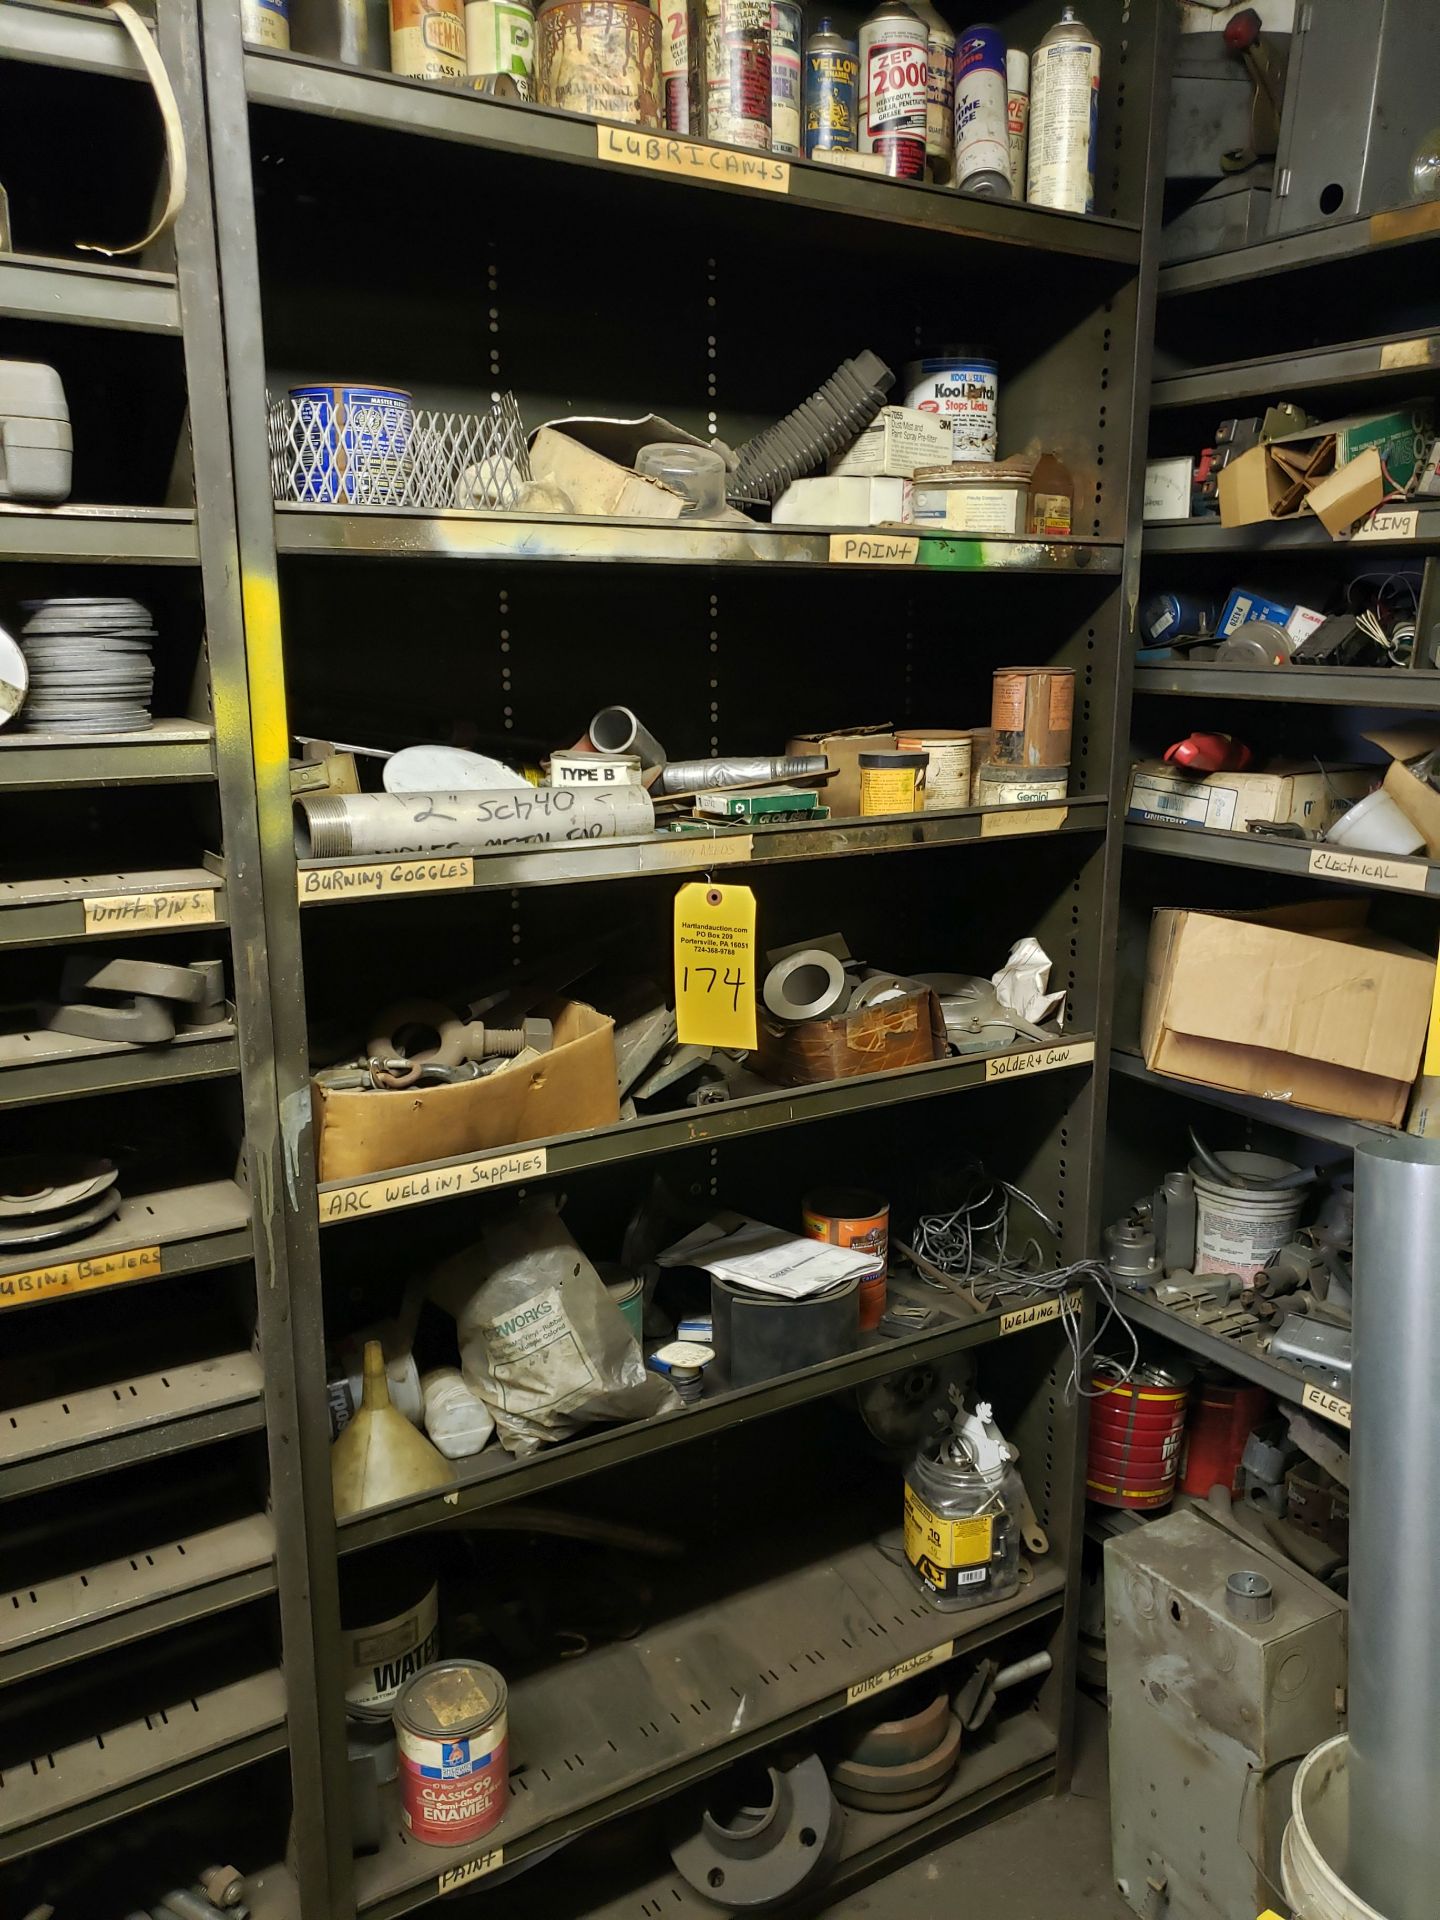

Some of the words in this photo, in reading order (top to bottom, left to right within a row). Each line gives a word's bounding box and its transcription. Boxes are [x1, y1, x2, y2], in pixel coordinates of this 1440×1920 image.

[811, 58, 859, 73] YELLOW
[878, 49, 912, 69] ZEP
[873, 62, 927, 97] 2000
[878, 110, 901, 121] GREASE
[935, 383, 966, 399] Kool
[945, 400, 968, 412] Stops
[970, 400, 988, 412] Leaks
[940, 420, 951, 430] 3M
[561, 767, 598, 782] TYPE
[604, 768, 615, 782] B
[1017, 791, 1049, 802] Gemini
[681, 922, 748, 934] Hartlandauction.com
[680, 936, 718, 947] Portersville,
[730, 941, 749, 949] 16051
[721, 932, 733, 940] 209
[694, 945, 735, 955] 724-368-9788
[683, 966, 746, 1012] 174
[329, 1190, 372, 1216] ARC
[543, 1323, 566, 1340] Colored
[924, 1578, 937, 1592] PRO
[473, 1776, 492, 1794] 99
[423, 1796, 494, 1821] ENAMEL
